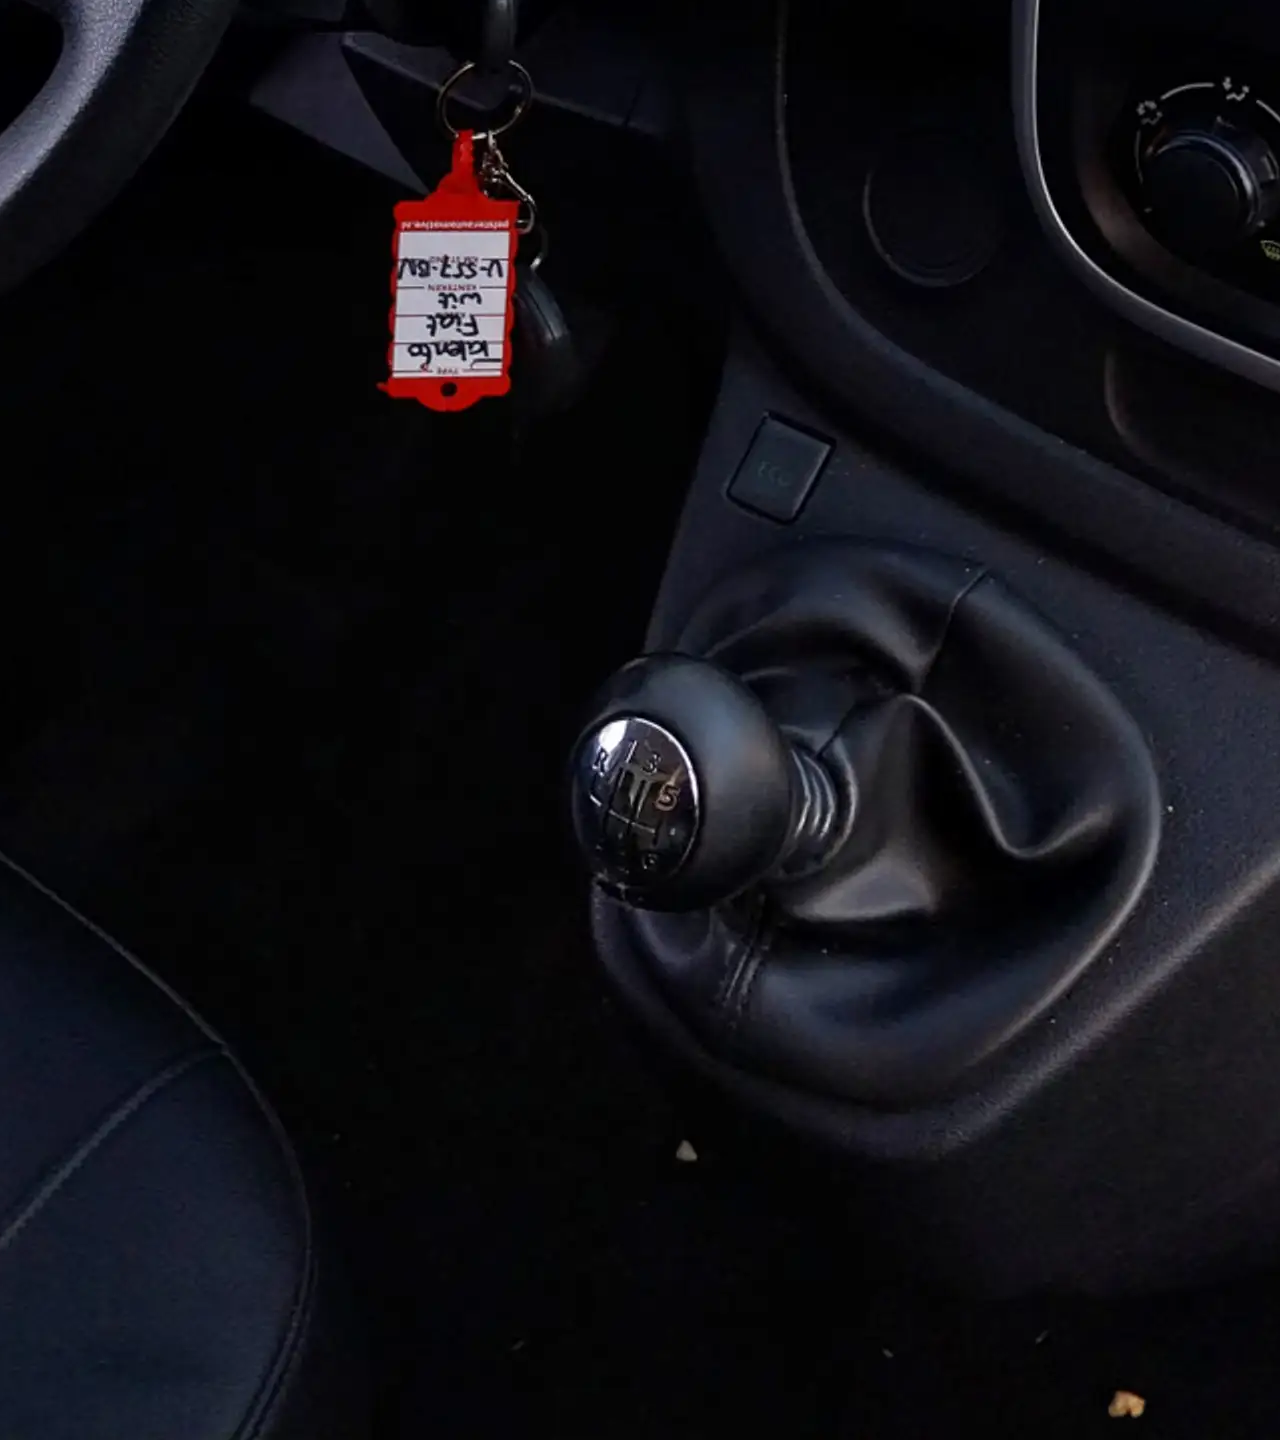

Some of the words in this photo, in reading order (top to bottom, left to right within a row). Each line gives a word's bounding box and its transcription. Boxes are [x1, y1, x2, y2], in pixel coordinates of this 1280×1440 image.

[437, 292, 482, 310] wit
[425, 312, 480, 338] Fiat
[655, 782, 682, 811] 5
